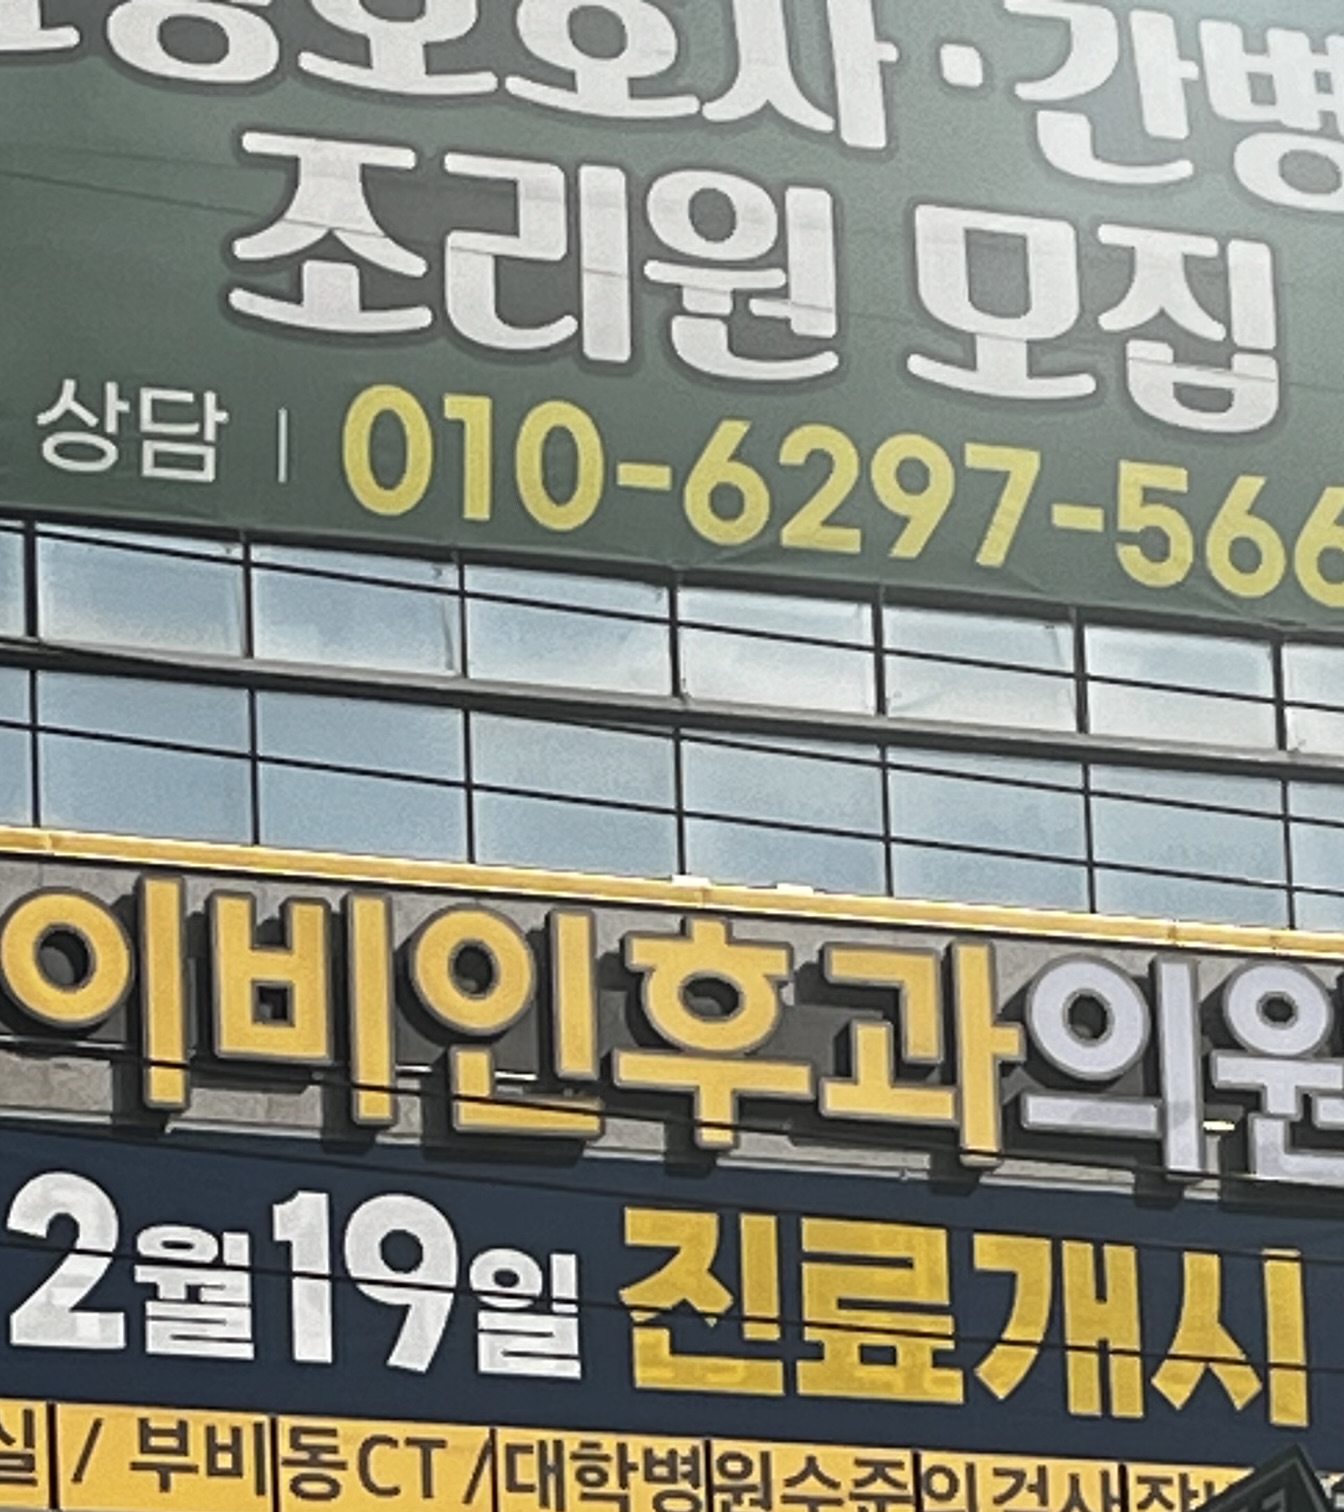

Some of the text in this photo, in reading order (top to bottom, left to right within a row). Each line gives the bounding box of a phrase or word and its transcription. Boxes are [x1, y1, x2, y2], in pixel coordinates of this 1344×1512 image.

[228, 130, 1283, 434] 조리원 모집
[34, 378, 229, 482] 상담
[617, 1204, 1311, 1428] 진료개시
[129, 1416, 448, 1501] 부비동CT
